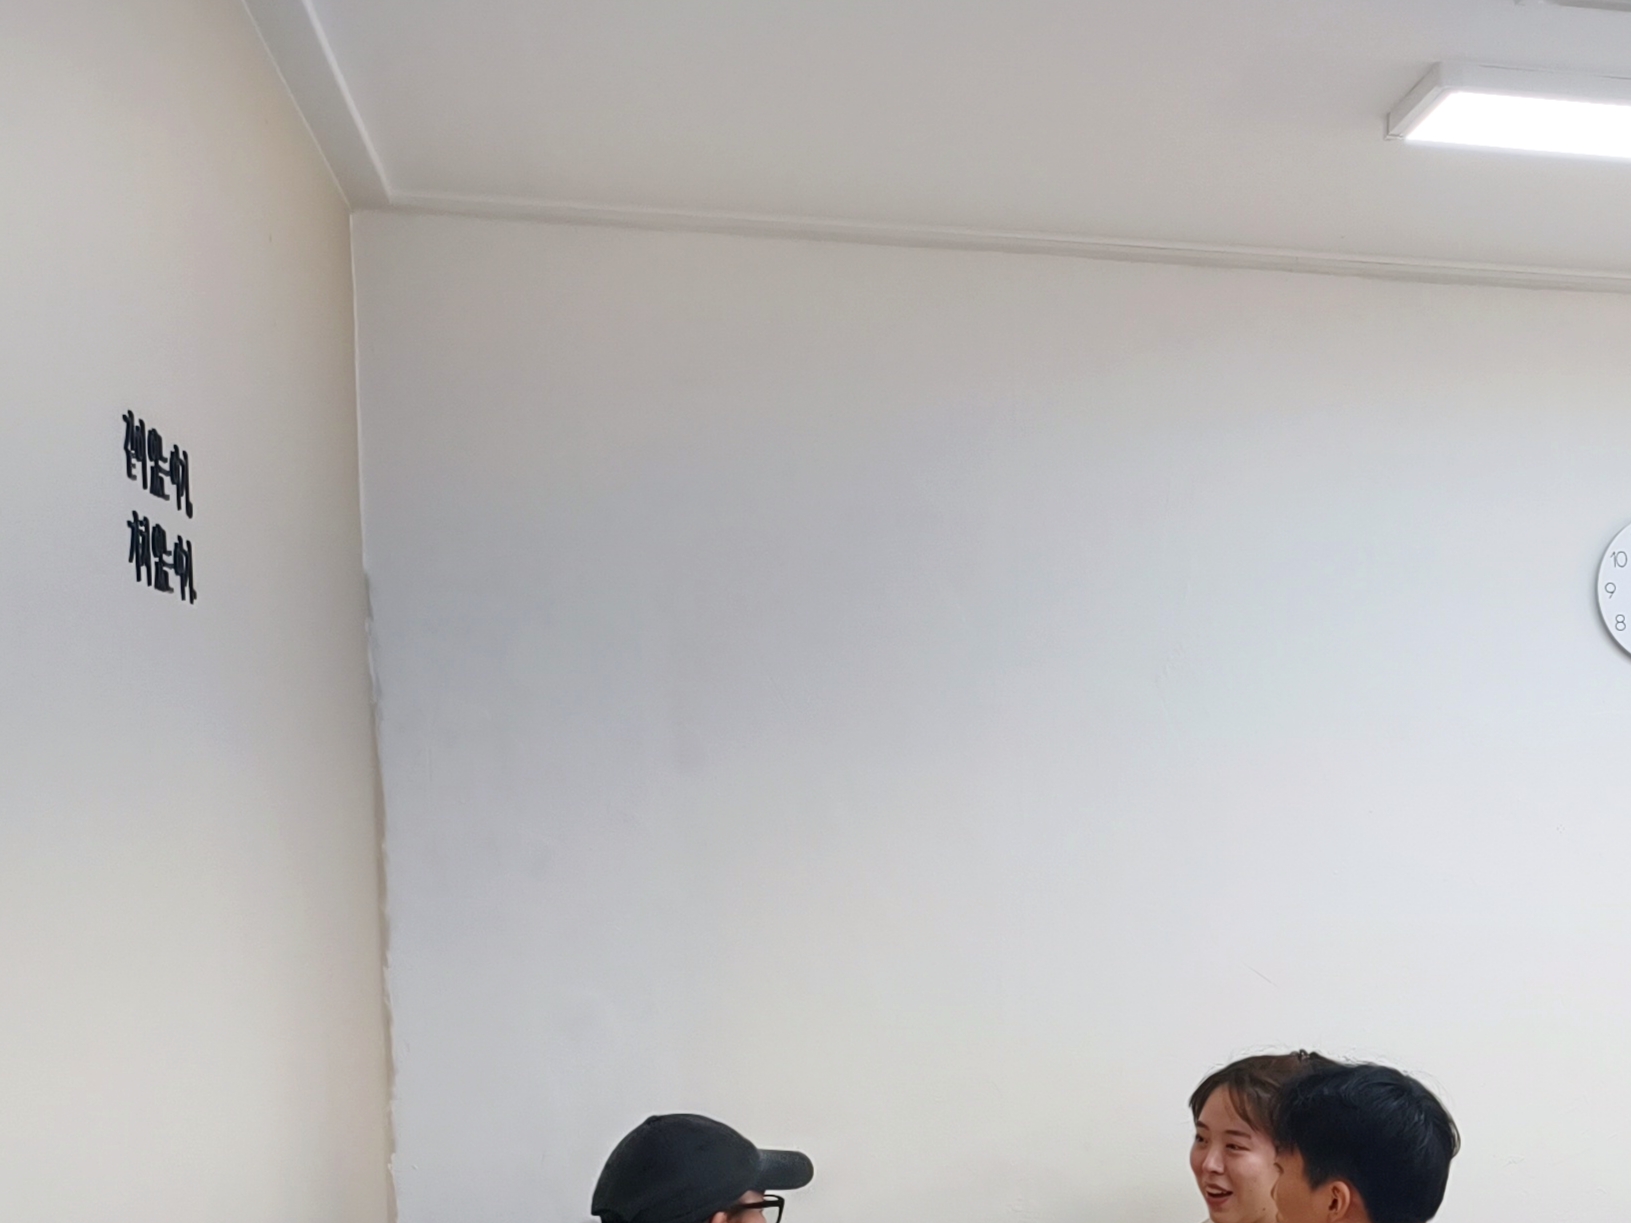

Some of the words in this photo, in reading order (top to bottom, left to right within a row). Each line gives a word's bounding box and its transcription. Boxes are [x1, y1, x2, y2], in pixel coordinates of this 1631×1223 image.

[1610, 550, 1628, 568] 10
[1604, 582, 1617, 599] 9
[1614, 614, 1627, 631] 8
